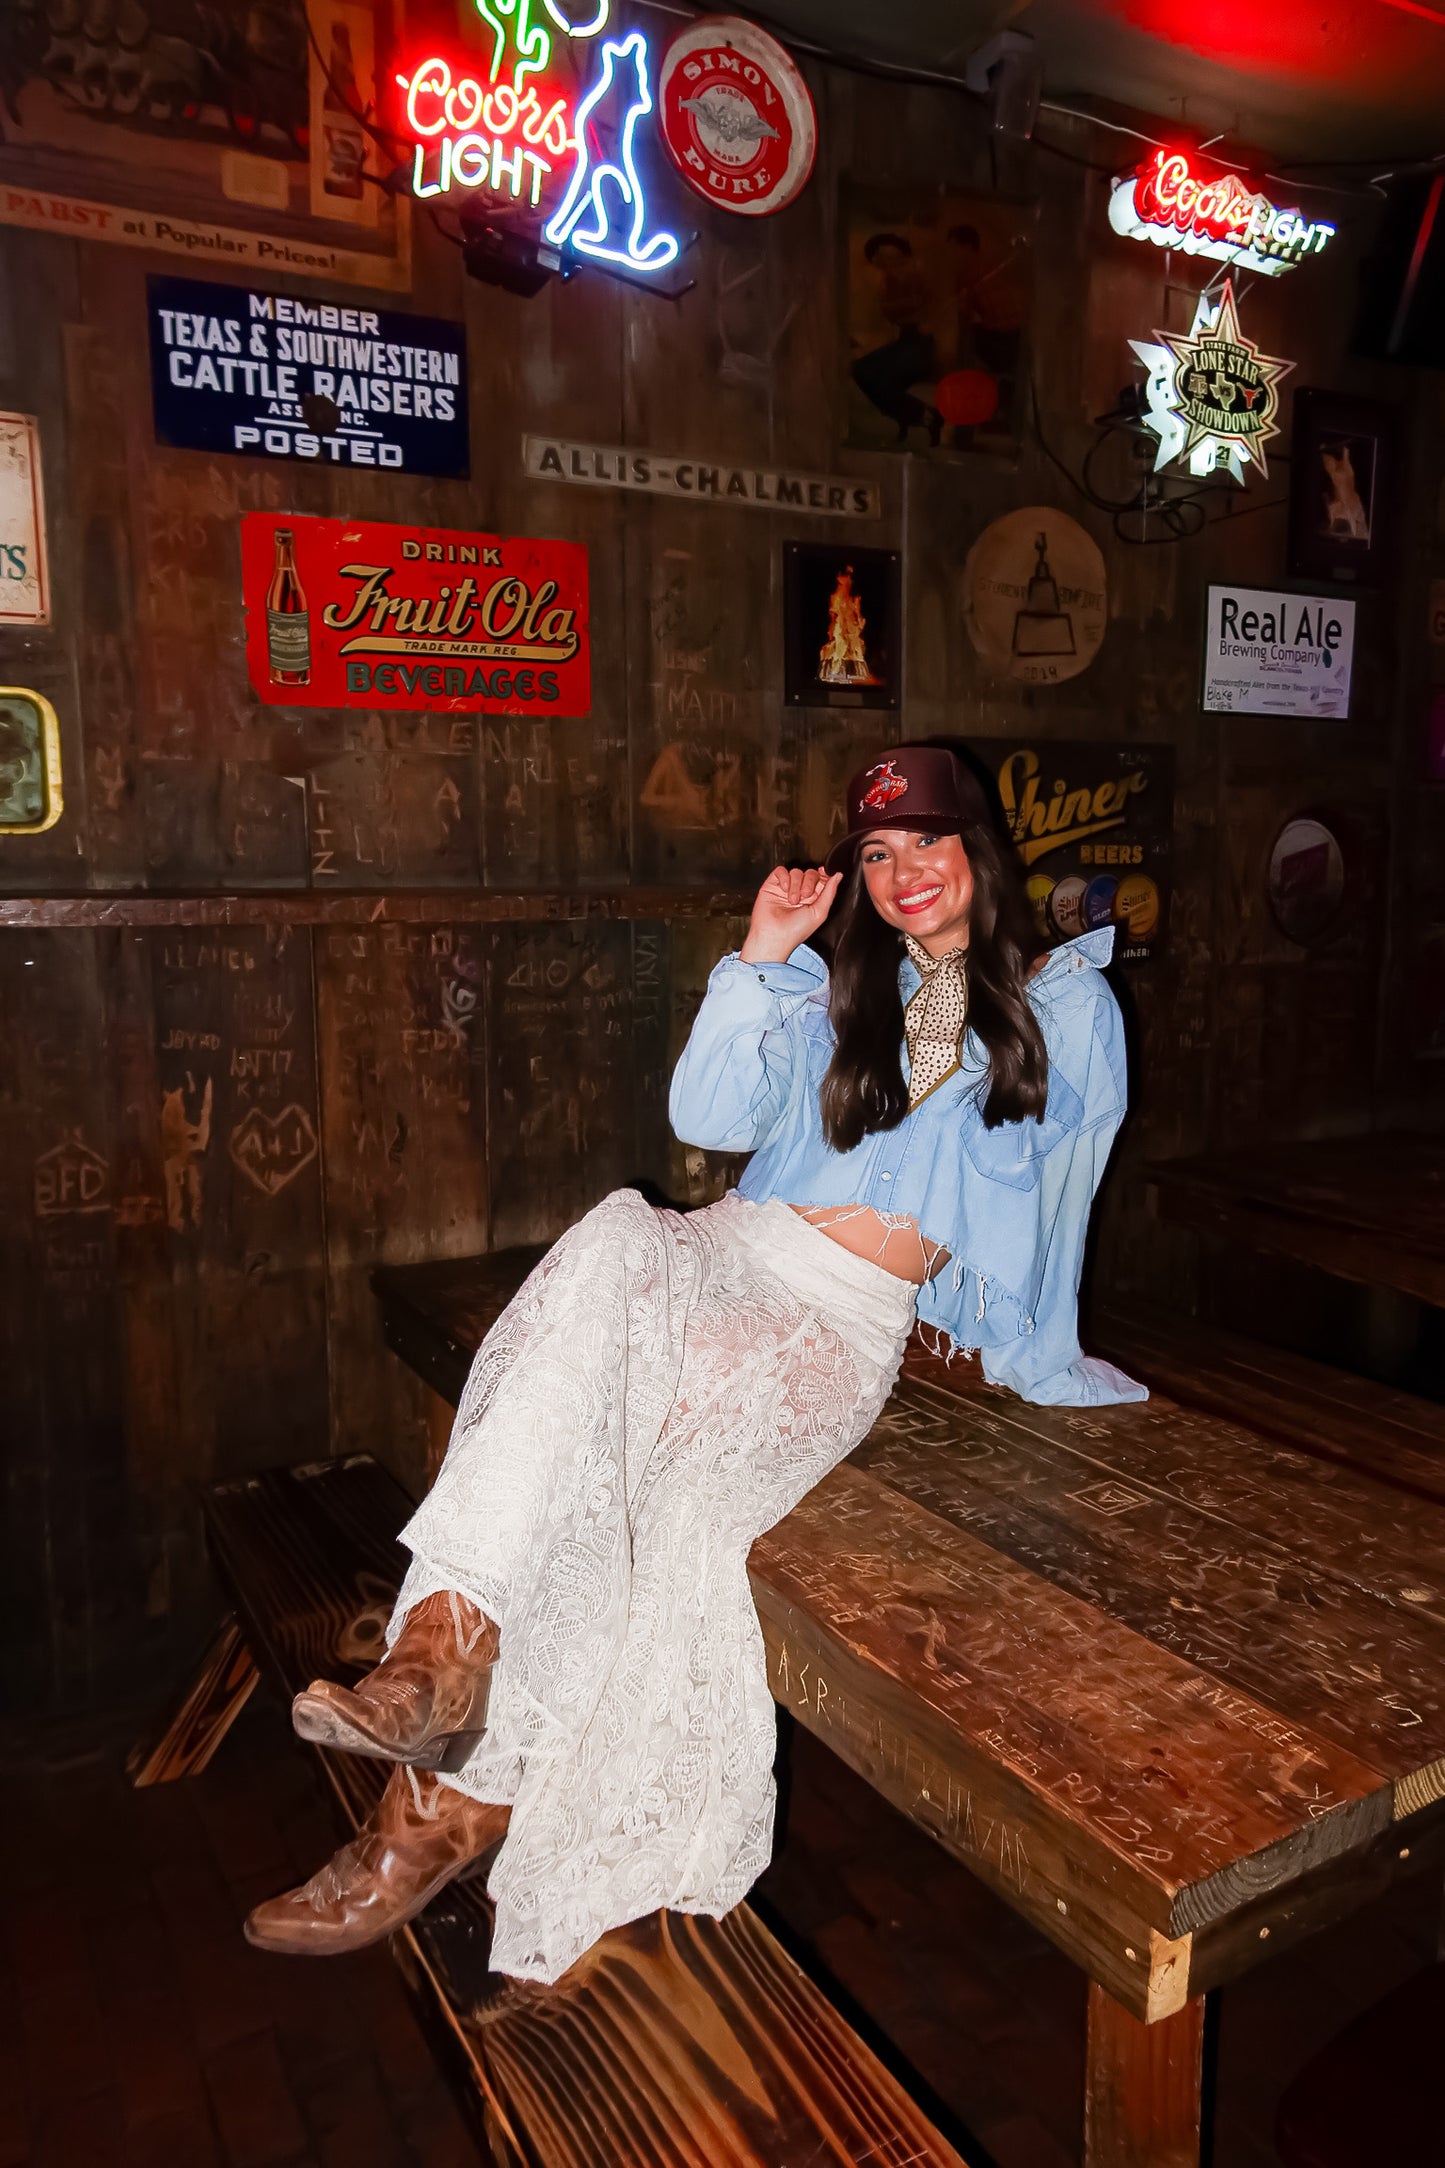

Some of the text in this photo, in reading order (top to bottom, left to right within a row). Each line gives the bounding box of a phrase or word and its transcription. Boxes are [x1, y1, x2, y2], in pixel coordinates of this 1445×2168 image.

[395, 57, 577, 155] Coors
[412, 133, 552, 206] LIGHT
[683, 145, 771, 194] PURE
[6, 193, 337, 269] PABST at Popular Prices!
[1249, 203, 1337, 252] LIGHT
[249, 294, 381, 336] MEMBER
[158, 309, 460, 386] TEXAS & SOUTHWESTERN
[1190, 350, 1226, 373] LONE
[1227, 353, 1260, 385] STAR
[168, 351, 456, 422] CATTLE RAISERS
[1188, 398, 1260, 433] SHOWDOWN
[234, 425, 404, 468] POSTED
[538, 446, 870, 513] ALLIS-CHALMERS
[402, 540, 502, 567] DRINK
[323, 564, 577, 644] Fruit-Ola
[1220, 597, 1343, 650] Real Ale
[403, 640, 444, 652] TRADE
[450, 643, 488, 655] MARK
[1219, 640, 1321, 668] Brewing Company
[346, 661, 560, 701] BEVERAGES
[998, 750, 1148, 840] Shiner
[1080, 844, 1144, 865] BEERS
